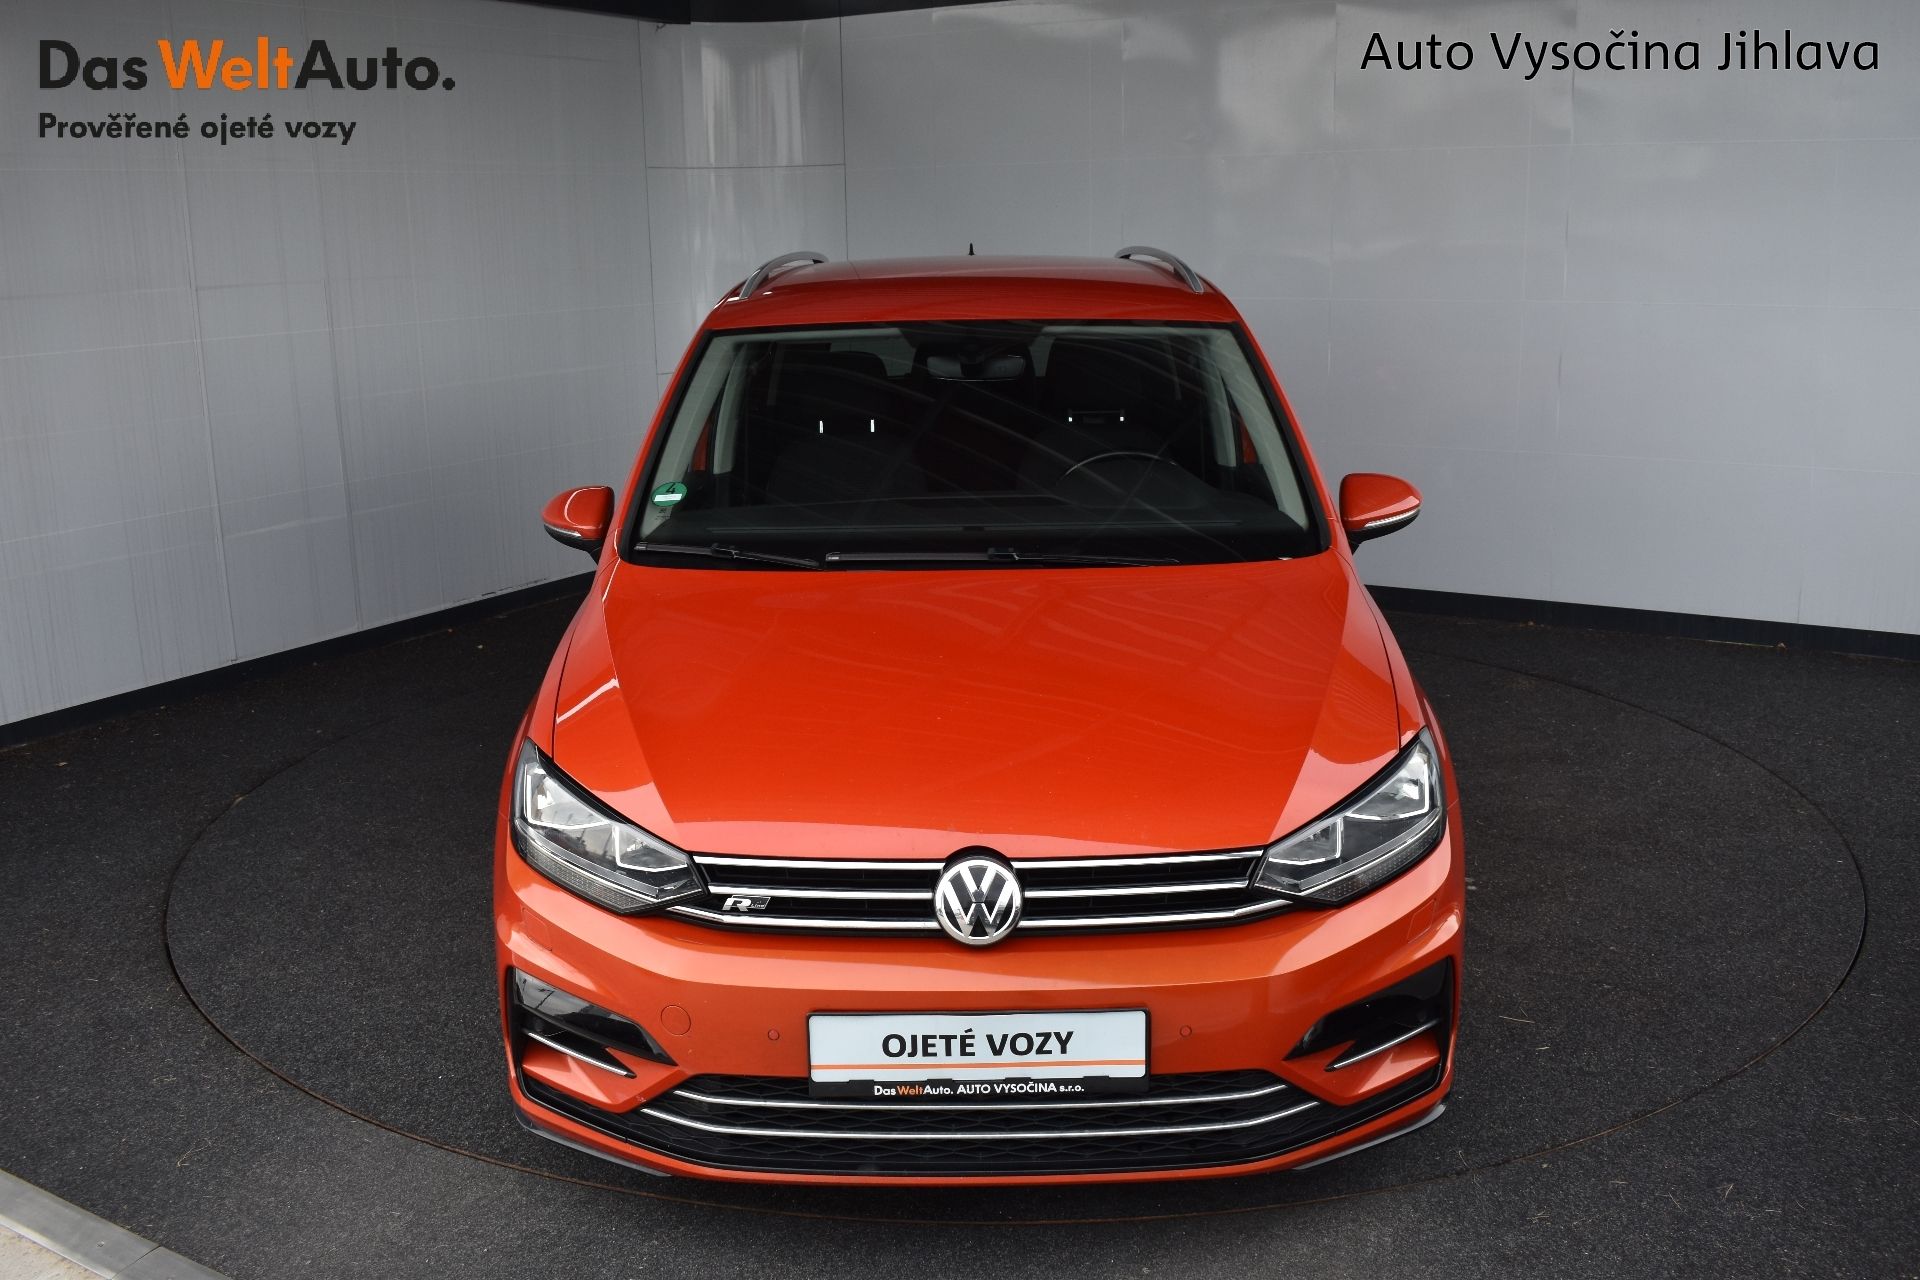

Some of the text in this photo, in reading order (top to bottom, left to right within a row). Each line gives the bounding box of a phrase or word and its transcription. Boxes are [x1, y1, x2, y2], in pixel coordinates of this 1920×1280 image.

[881, 1028, 1075, 1058] OJETÉ VOZY
[873, 1085, 896, 1096] Das
[956, 1083, 992, 1095] AUTO
[993, 1081, 1058, 1095] VYSOČINA
[1059, 1084, 1085, 1093] s.r.o.
